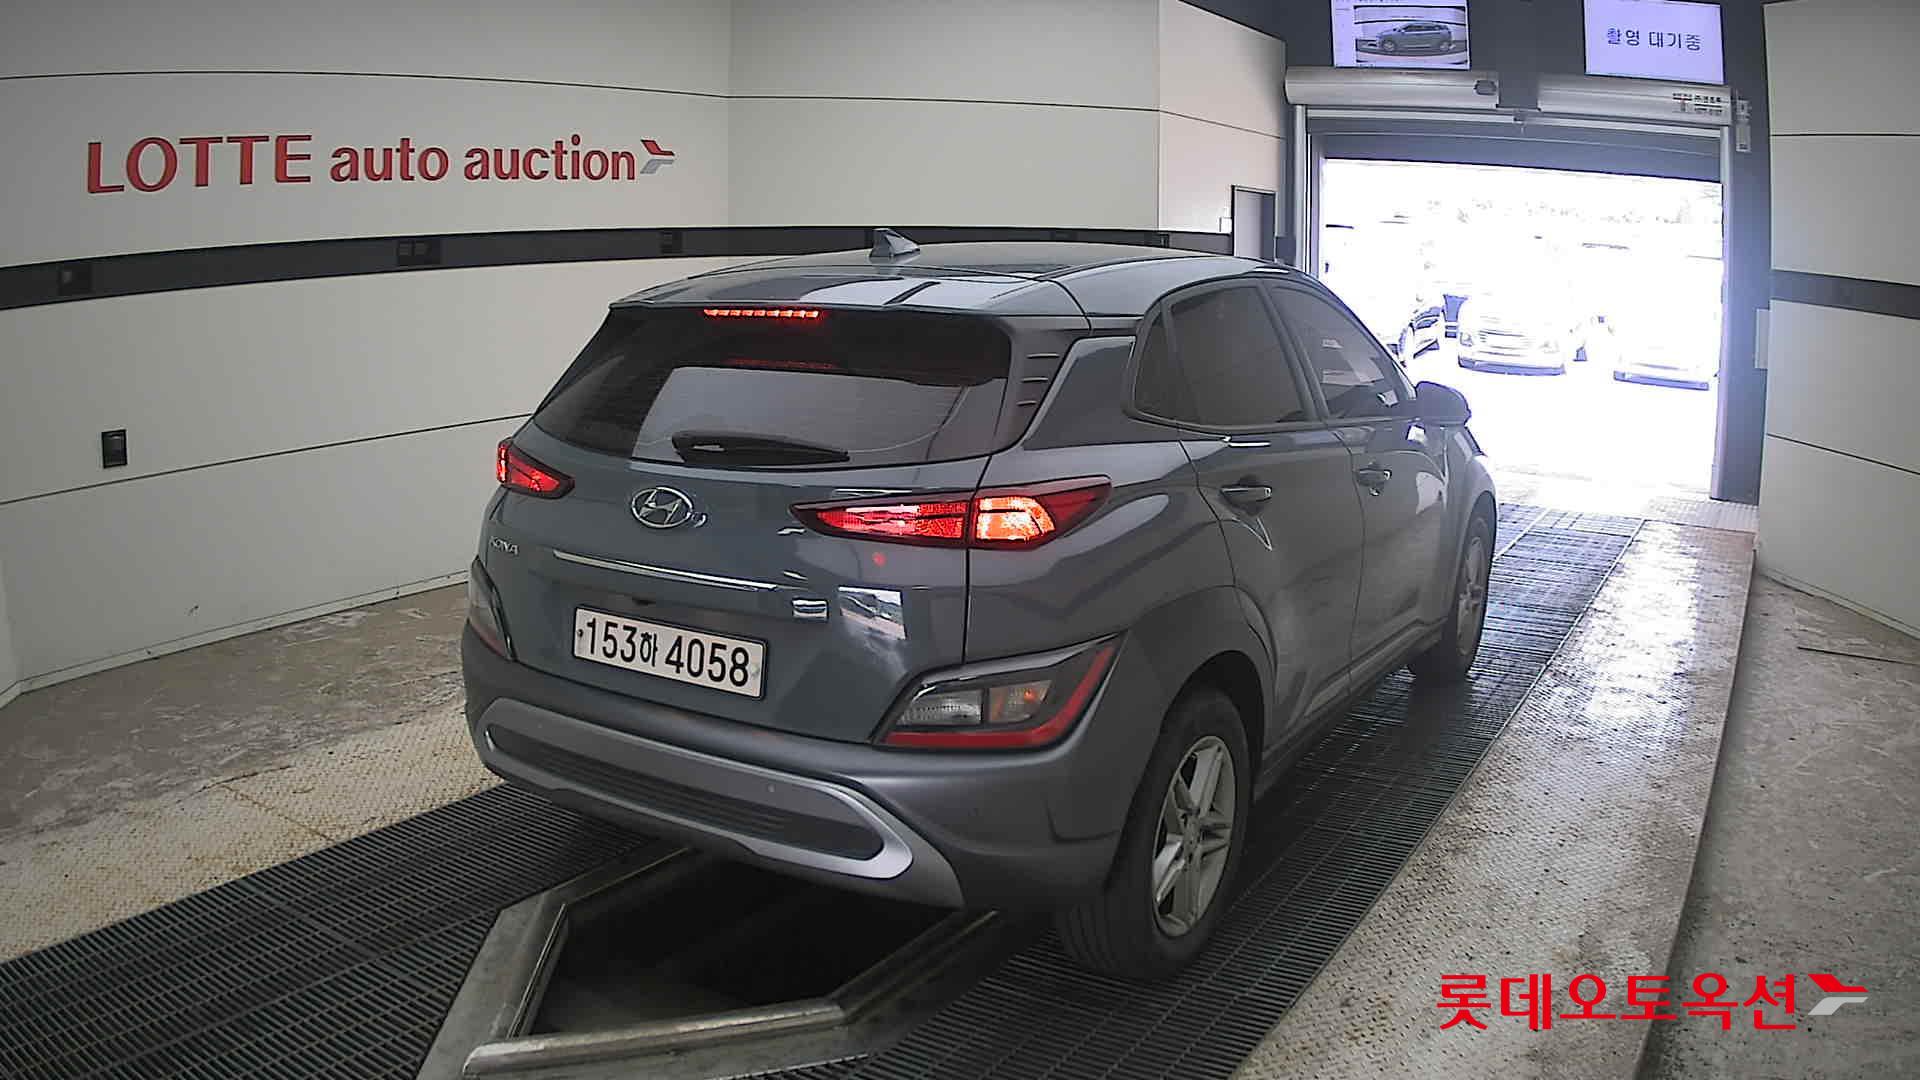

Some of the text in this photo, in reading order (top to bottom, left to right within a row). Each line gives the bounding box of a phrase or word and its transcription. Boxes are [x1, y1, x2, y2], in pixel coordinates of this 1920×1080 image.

[1648, 31, 1701, 51] 대기중
[87, 134, 635, 193] LOTTE auto auction
[587, 617, 749, 687] 153하 4058
